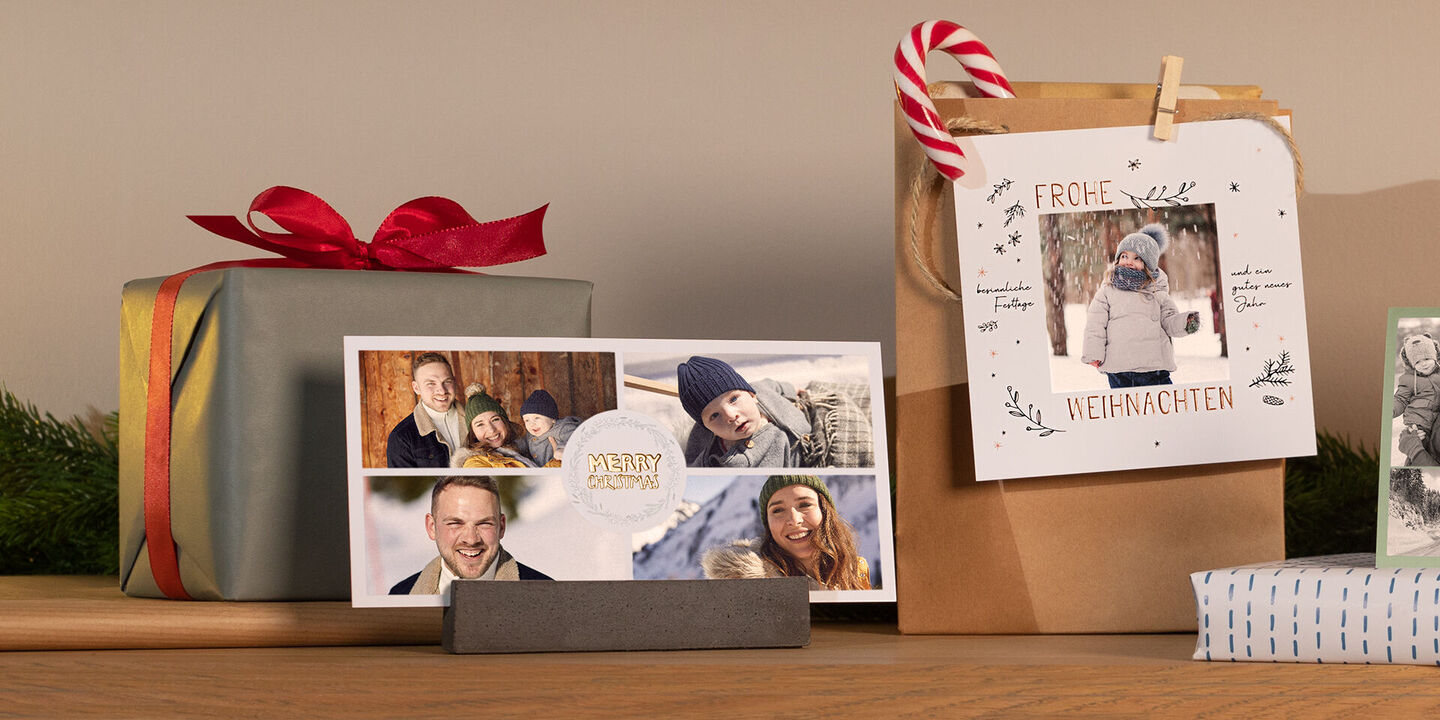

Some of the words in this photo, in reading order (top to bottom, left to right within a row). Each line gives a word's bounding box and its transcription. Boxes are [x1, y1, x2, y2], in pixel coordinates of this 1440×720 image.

[1034, 179, 1113, 209] FROHE
[1230, 263, 1252, 277] und
[976, 280, 1032, 295] besinnliche
[1231, 278, 1261, 296] gutes
[994, 295, 1035, 313] Festtage
[1233, 295, 1267, 313] Jahr
[1066, 385, 1234, 421] WEIHNACHTEN
[587, 453, 661, 473] MERRY
[586, 474, 660, 491] CHRISTMAS
